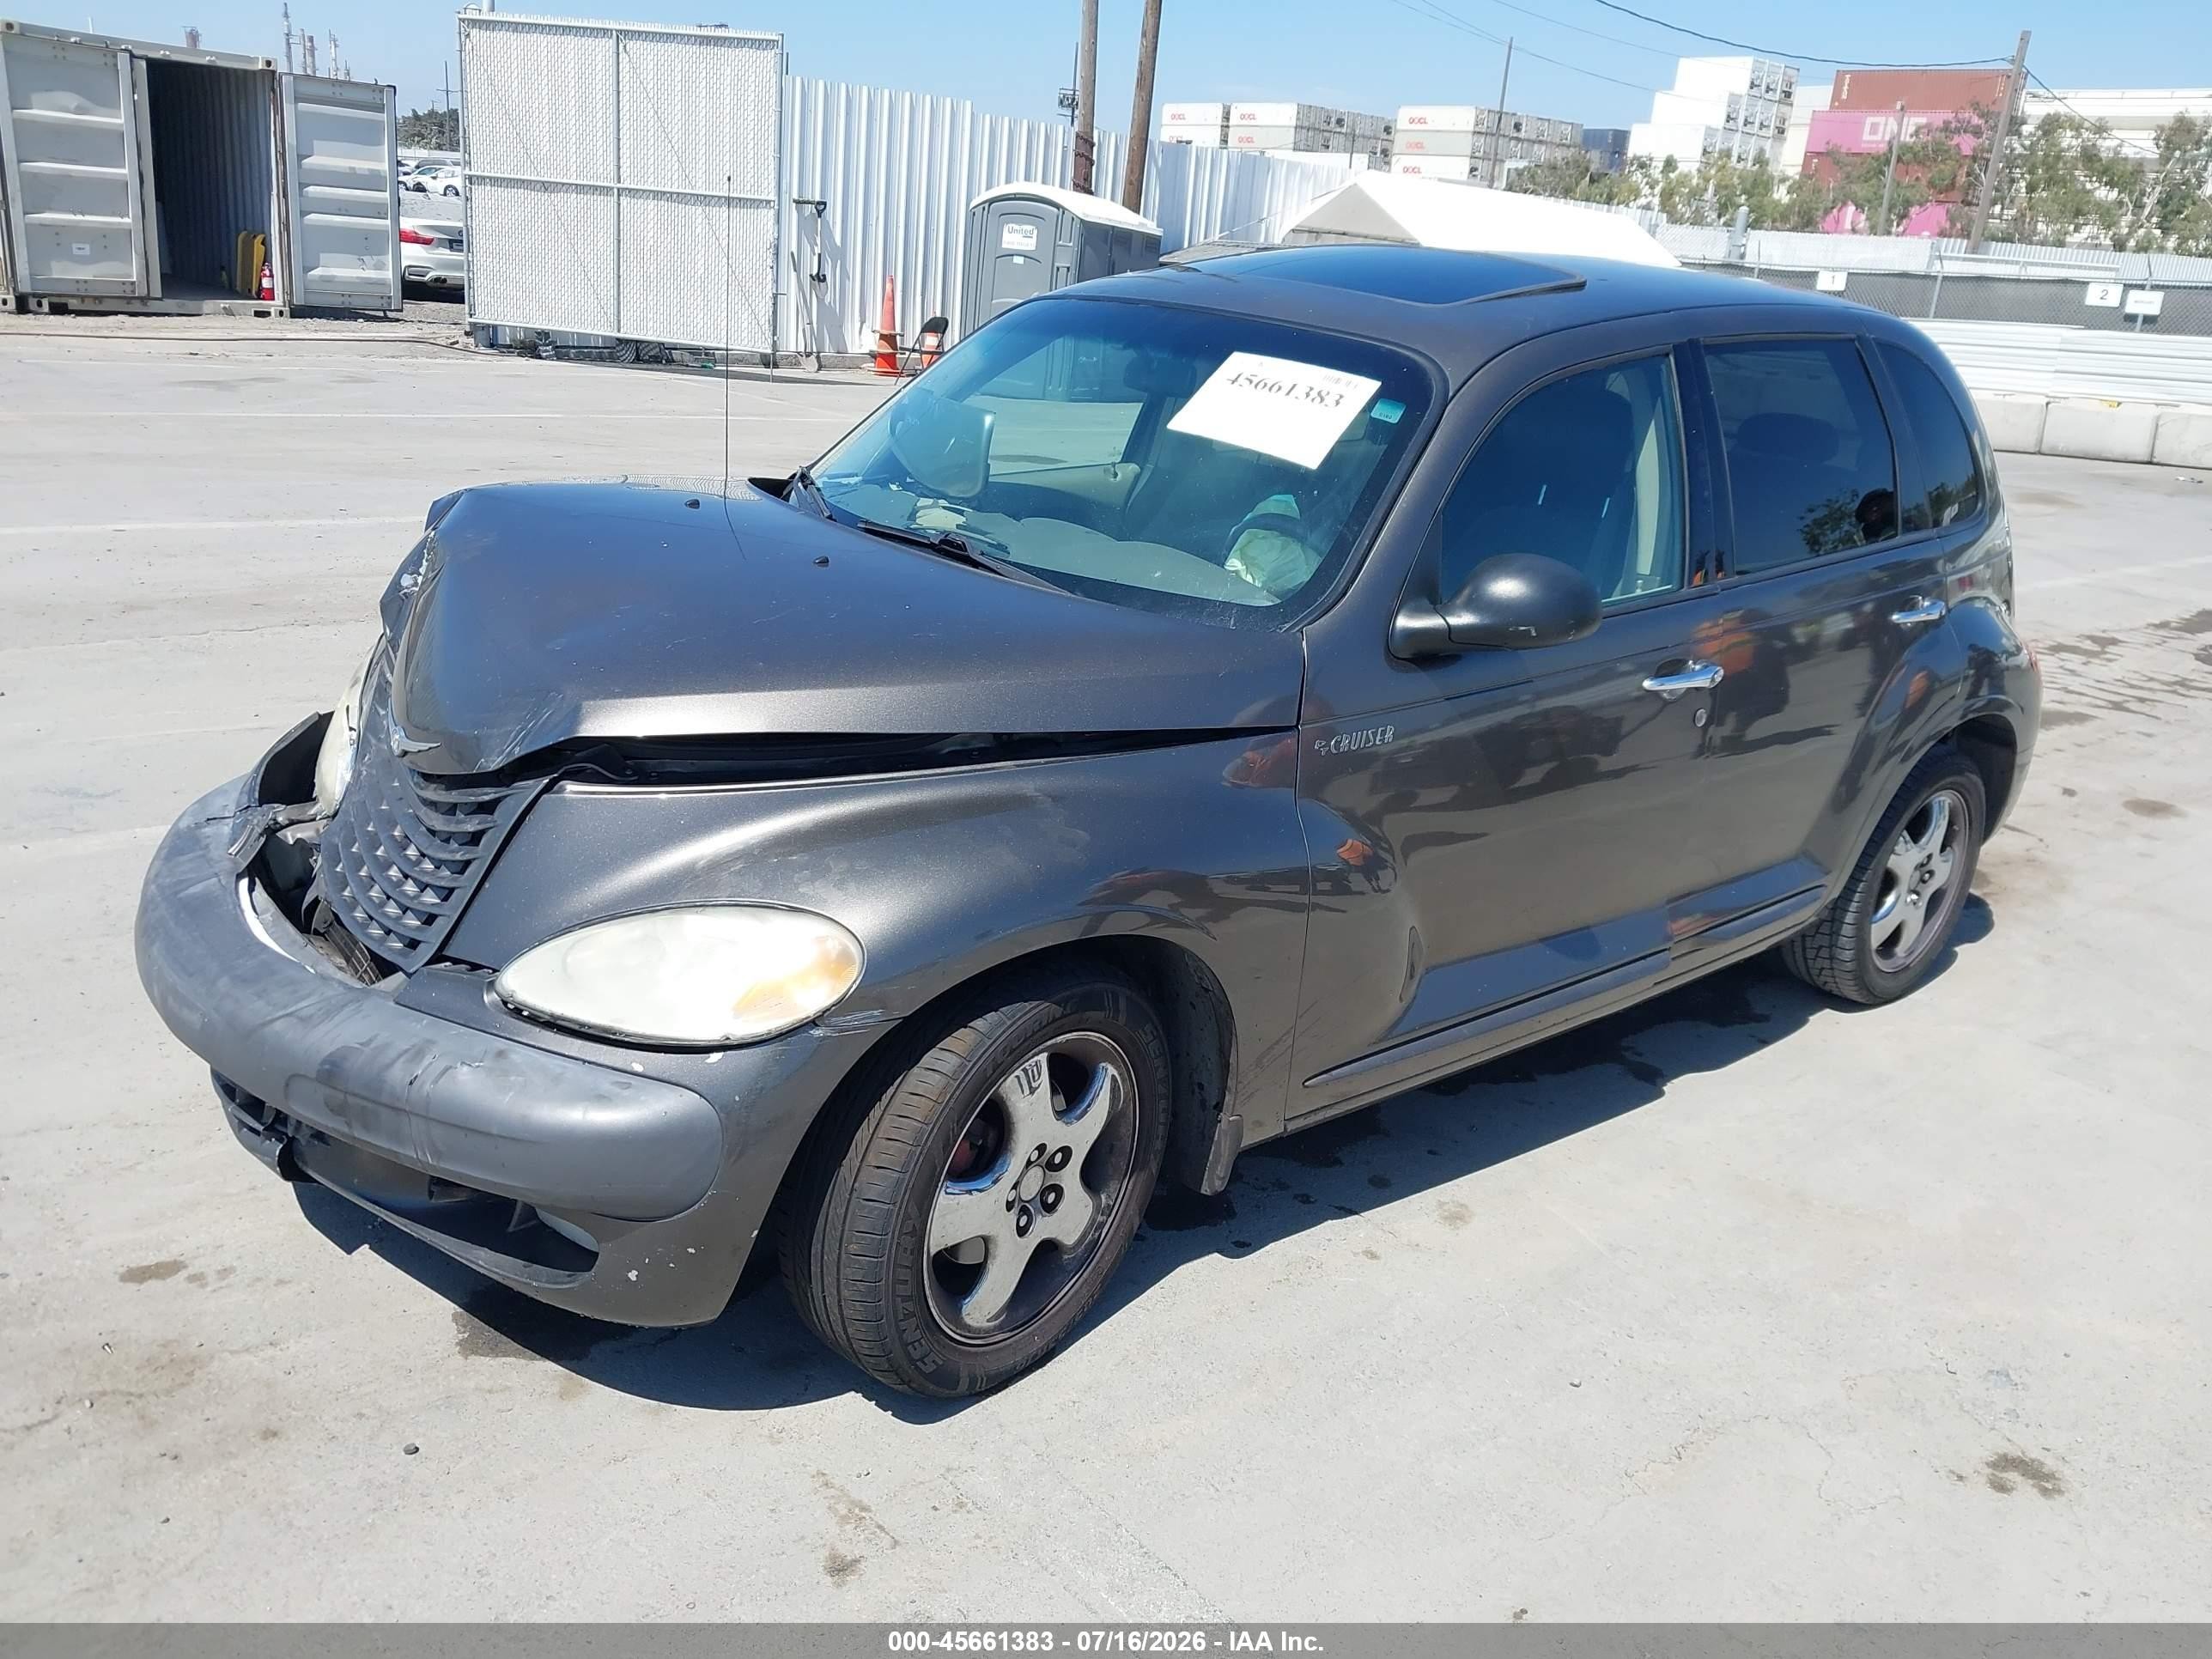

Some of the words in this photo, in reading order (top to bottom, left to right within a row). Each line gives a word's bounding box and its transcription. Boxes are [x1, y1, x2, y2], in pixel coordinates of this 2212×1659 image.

[1409, 116, 1428, 125] OOCL
[1406, 141, 1425, 149] OOCL
[1007, 225, 1036, 235] United
[2100, 289, 2109, 301] 2
[1226, 371, 1345, 408] 45661383
[1330, 725, 1395, 754] CRUISER
